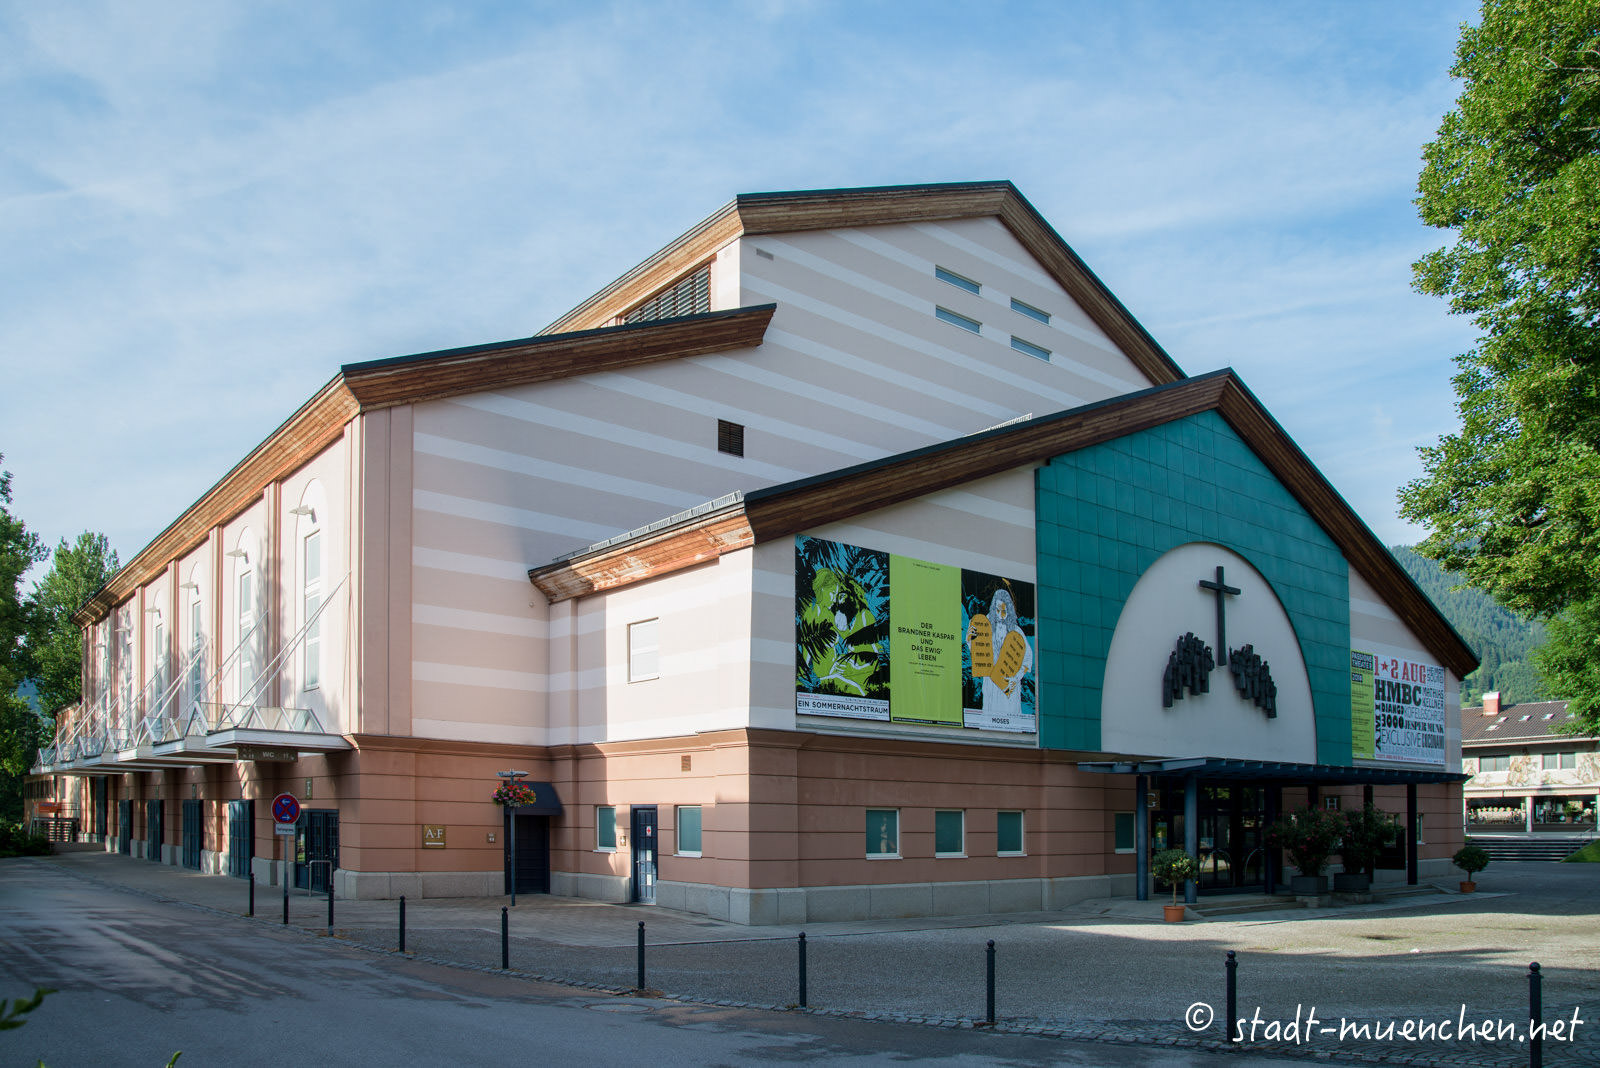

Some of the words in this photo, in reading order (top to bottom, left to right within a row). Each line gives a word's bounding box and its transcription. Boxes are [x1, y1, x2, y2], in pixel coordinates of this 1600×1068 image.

[920, 621, 933, 630] DER
[897, 626, 931, 638] BRANDNER
[932, 630, 955, 641] KASPAR
[911, 644, 924, 654] DAS
[920, 638, 934, 646] UND
[917, 653, 937, 662] LEBEN
[1374, 656, 1380, 676] 1
[1390, 659, 1399, 679] 2
[1401, 661, 1427, 684] AUG
[1374, 678, 1422, 706] HMBC
[797, 699, 810, 708] EIN
[811, 701, 889, 714] SOMMERNACHTSTRAUM
[991, 716, 1010, 725] MOSES
[1381, 713, 1404, 729] 3000
[1381, 729, 1422, 747] EXCLUSIVE
[1325, 797, 1338, 810] H
